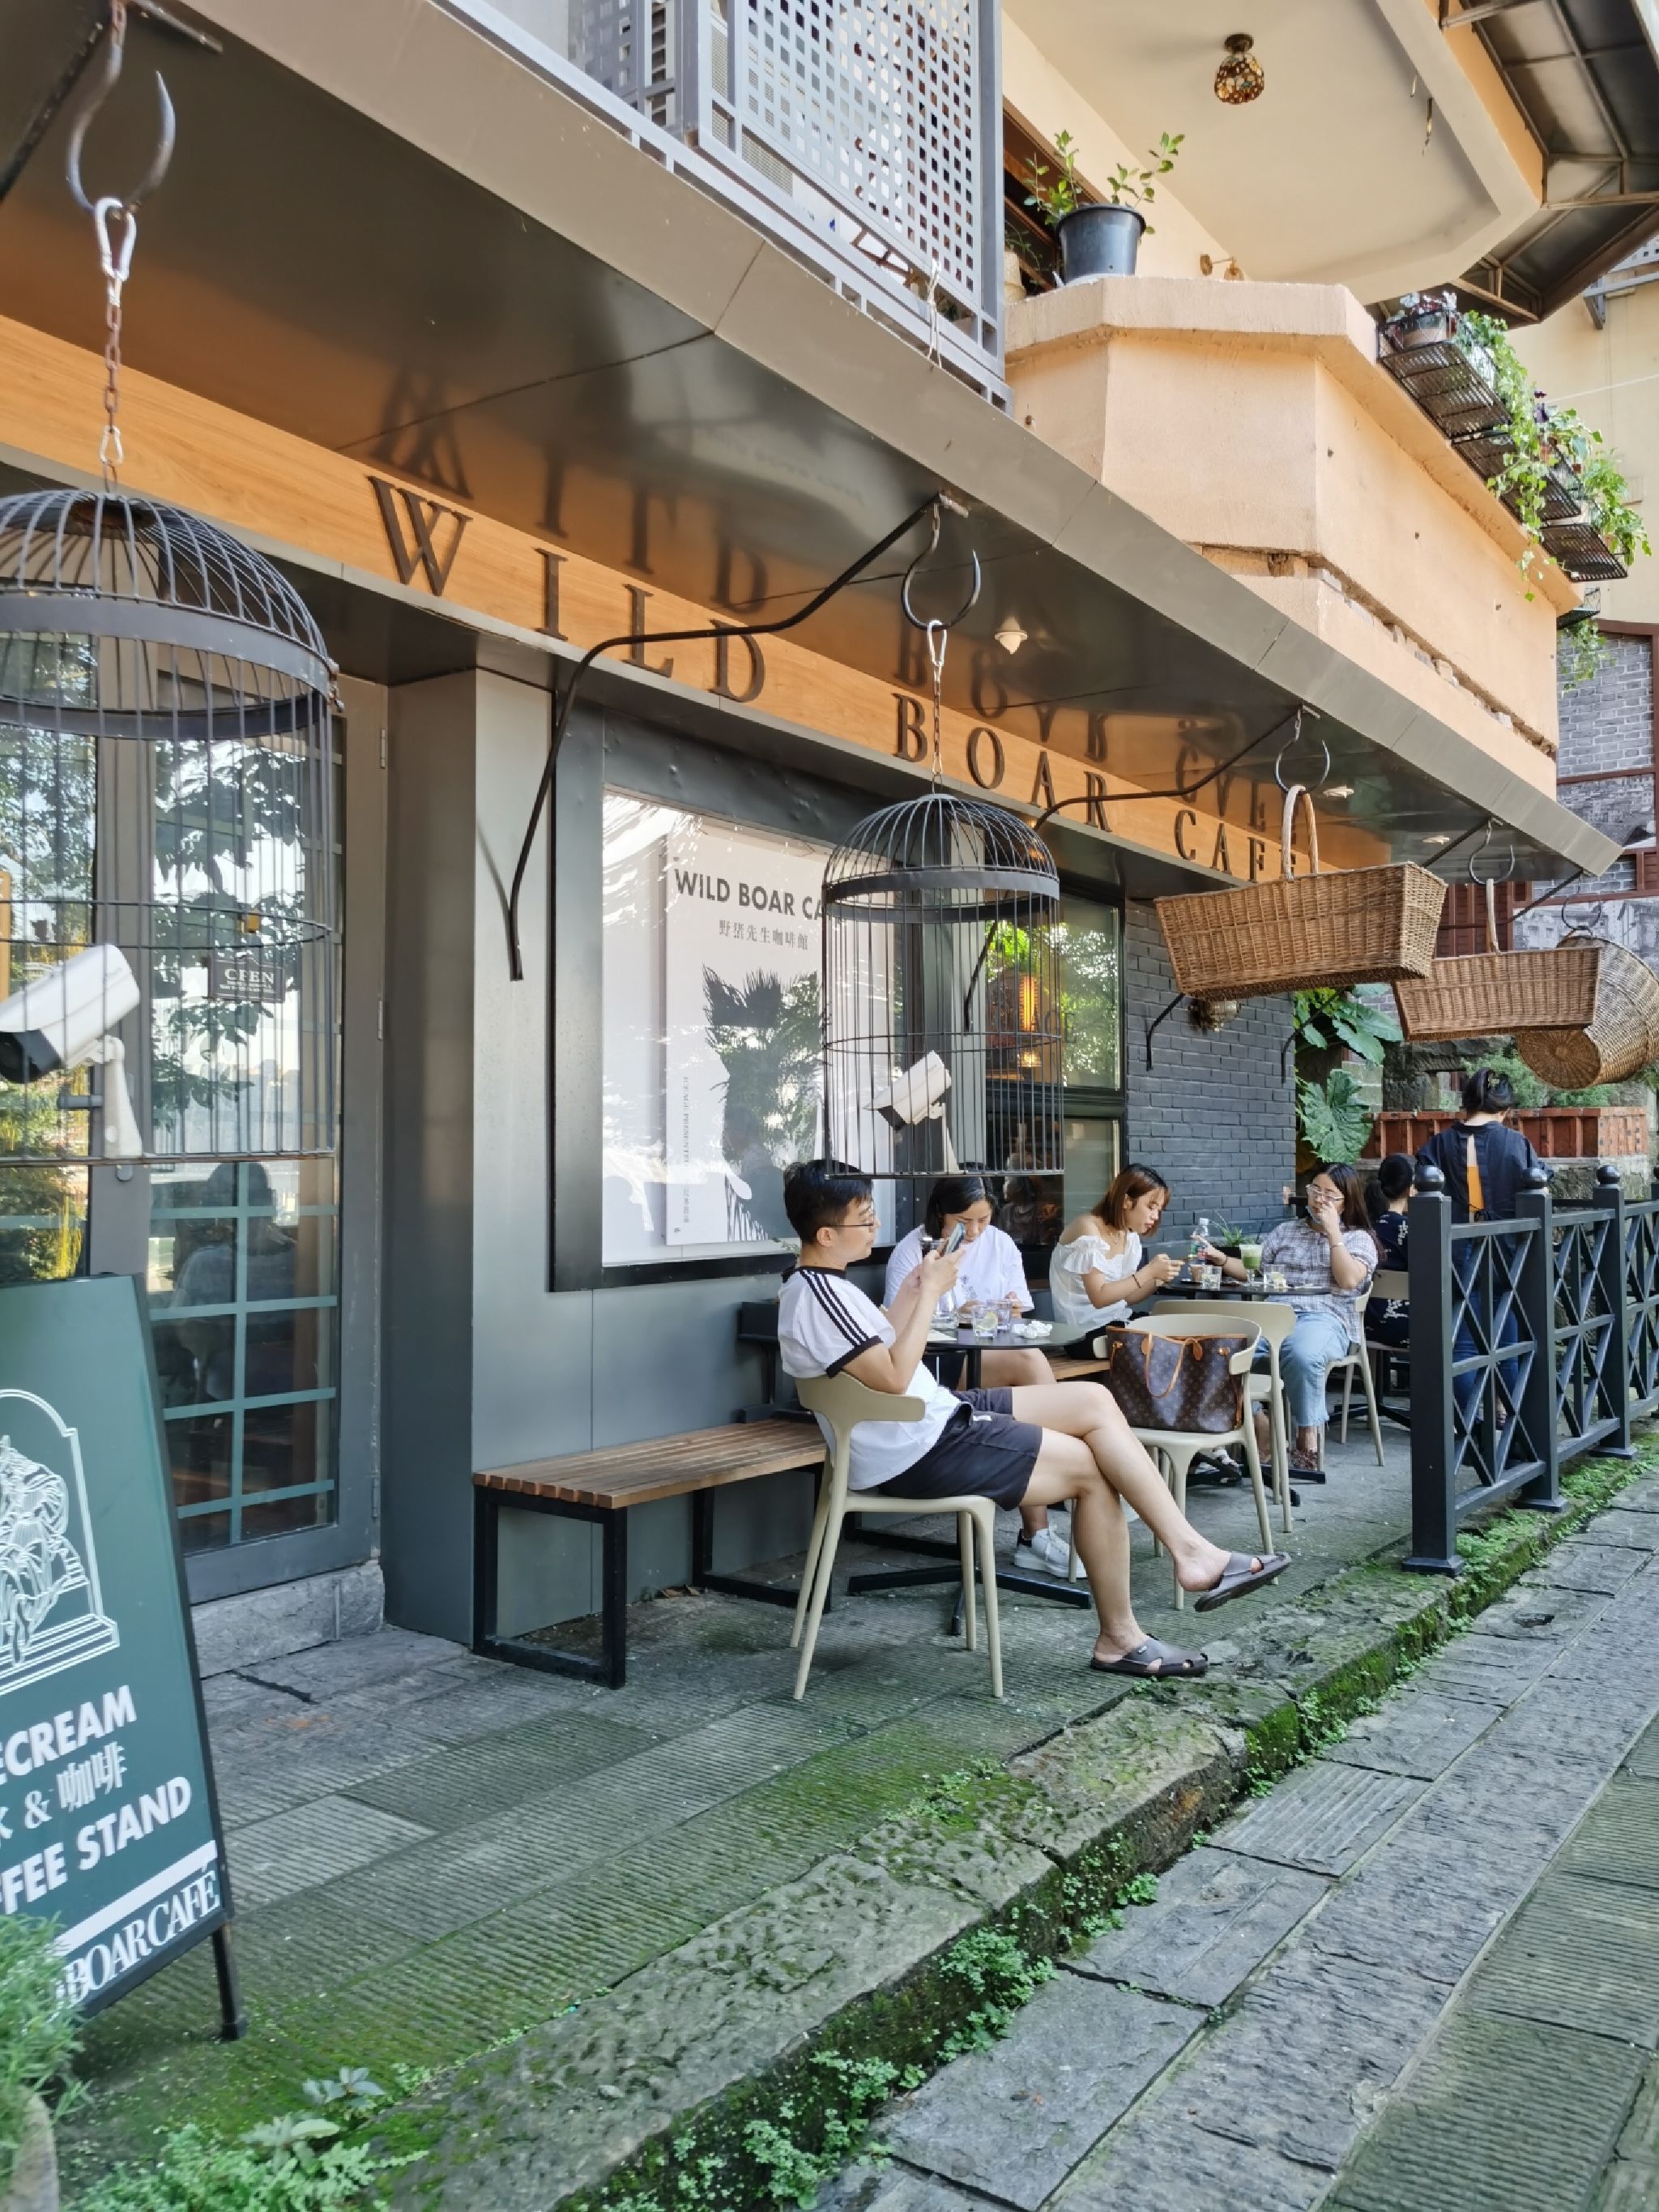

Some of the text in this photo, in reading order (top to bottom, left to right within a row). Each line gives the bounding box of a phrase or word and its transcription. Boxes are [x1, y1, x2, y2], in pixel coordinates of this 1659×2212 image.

[366, 475, 766, 702] WILD
[893, 693, 1112, 832] BOAR
[674, 869, 731, 903] WILD
[739, 882, 795, 916] BOAR
[0, 1685, 137, 1783] CREAM
[24, 1790, 52, 1829] &
[56, 1741, 127, 1812] 咖啡
[0, 1842, 68, 1915] FEE
[77, 1776, 191, 1870] STAND
